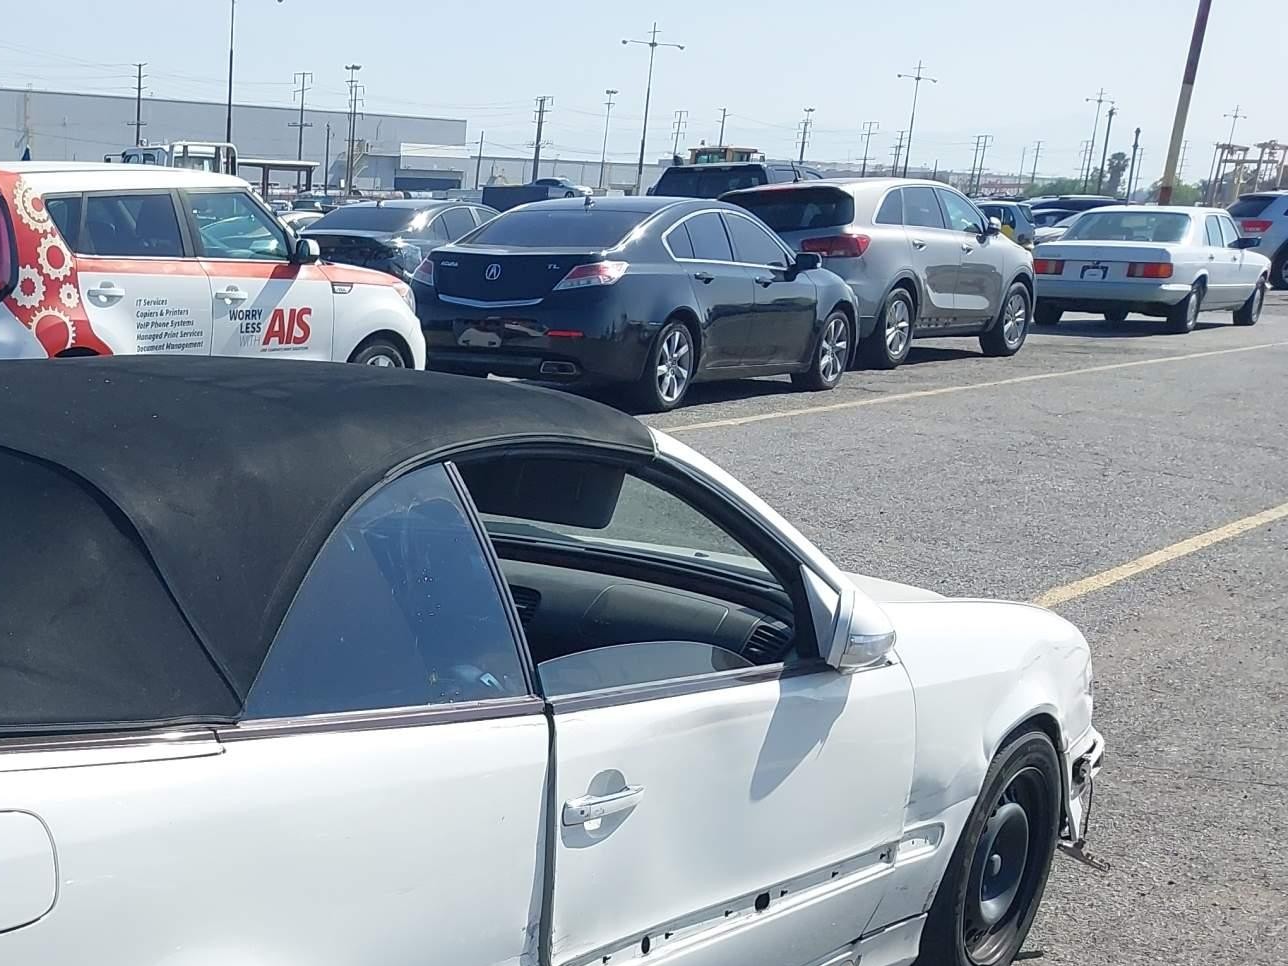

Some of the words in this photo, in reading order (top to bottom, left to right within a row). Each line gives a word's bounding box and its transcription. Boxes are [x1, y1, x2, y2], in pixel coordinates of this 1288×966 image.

[136, 298, 143, 307] IT
[143, 298, 168, 307] Services
[136, 309, 158, 319] Copiers
[159, 309, 165, 317] &
[166, 307, 189, 317] Printers
[229, 309, 263, 321] WORRY
[136, 321, 150, 330] VoIP
[150, 319, 169, 329] Phone
[170, 319, 195, 329] Systems
[240, 322, 262, 334] LESS
[262, 307, 312, 346] AIS
[136, 331, 163, 342] Managed
[164, 330, 179, 339] Print
[179, 328, 203, 338] Services
[136, 343, 165, 353] Document
[165, 340, 204, 352] Management
[239, 336, 261, 347] WITH
